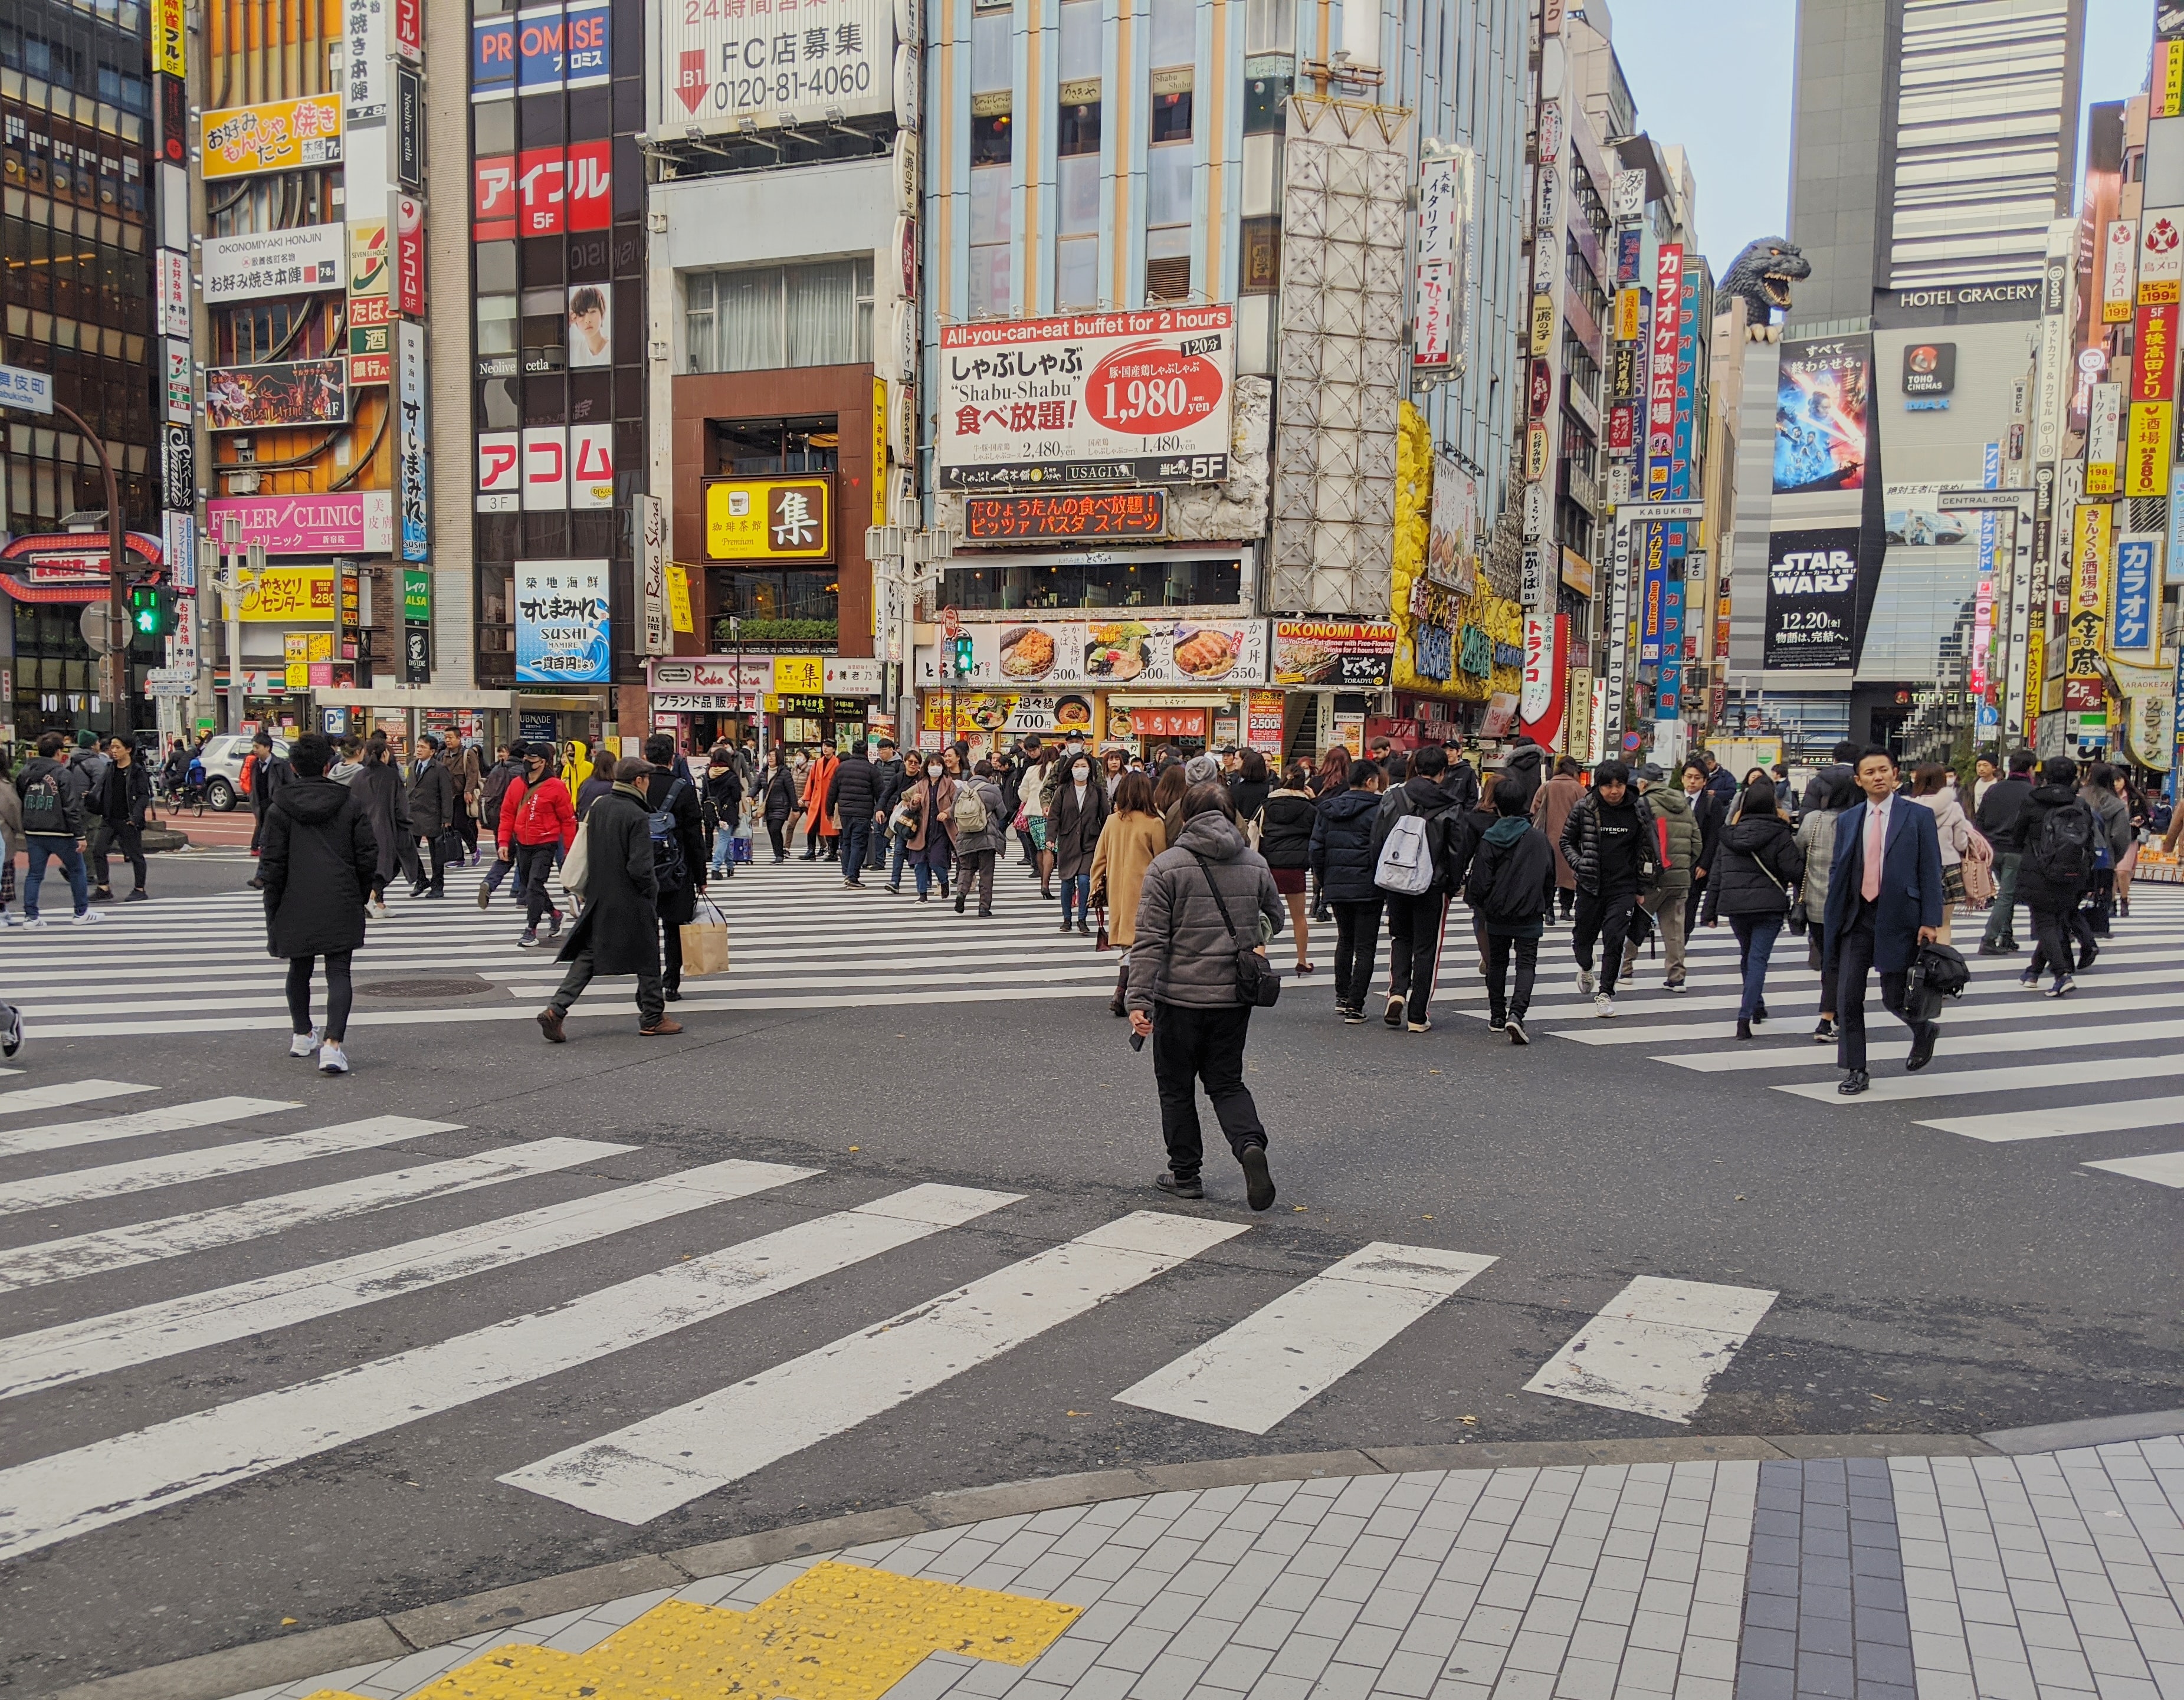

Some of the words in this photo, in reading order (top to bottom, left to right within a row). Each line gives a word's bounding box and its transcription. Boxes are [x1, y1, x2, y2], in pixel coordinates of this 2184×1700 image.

[402, 44, 414, 57] 5F
[481, 17, 604, 64] PROMISE
[722, 22, 863, 72] FC店募集
[166, 61, 179, 72] 6F
[683, 70, 703, 88] B1
[714, 62, 870, 110] 0120-81-4060
[1155, 75, 1178, 83] Shabu
[1168, 81, 1192, 90] Shabu
[292, 103, 336, 137] 焼き
[207, 112, 257, 150] お好み
[224, 118, 286, 162] もんじゃ
[257, 133, 292, 166] たこ
[326, 140, 340, 159] 7F
[479, 157, 611, 209] アイフル
[533, 212, 554, 229] 5F
[1426, 179, 1439, 253] イタリアン
[1539, 216, 1552, 225] 6F
[218, 238, 283, 255] OKONOMIYAKI
[286, 233, 322, 247] HONJIN
[251, 253, 296, 267] 歌舞伎町名物
[402, 241, 417, 294] アコム
[2143, 261, 2178, 272] 鳥メロ
[211, 265, 302, 293] お好み焼き本陣
[2112, 261, 2127, 297] 鳥メロ
[2142, 282, 2177, 291] 生ビール
[405, 297, 416, 308] 3F
[1901, 291, 1955, 307] HOTEL
[1958, 284, 2039, 303] GRACERY
[1424, 281, 1442, 352] ひょうたん
[2109, 307, 2129, 316] 199
[2150, 307, 2165, 317] 5F
[946, 320, 1070, 347] All-you-can-eat
[1074, 317, 1124, 335] buffet
[1129, 314, 1154, 330] for
[1159, 314, 1171, 329] 2
[1176, 311, 1228, 328] hours
[1536, 310, 1552, 340] 虎の子
[365, 329, 386, 350] 酒
[1183, 337, 1219, 357] 120分
[1651, 251, 1681, 424] カラオケ歌広場
[2048, 320, 2058, 369] ネットカフェ
[1424, 354, 1438, 362] 7F
[1806, 343, 1844, 358] すべて
[2143, 319, 2166, 398] 豊後高田どり
[407, 338, 416, 393] 築地海鮮
[478, 361, 516, 375] Neolive
[525, 359, 549, 371] cetla
[951, 346, 1084, 382] しゃぶしゃぶ
[1791, 357, 1862, 374] 終わらせる。
[1907, 382, 1942, 390] CINEMAS
[1908, 375, 1934, 383] TOHO
[173, 401, 187, 410] ATM
[324, 402, 339, 416] 4F
[1103, 377, 1187, 425] 1,980
[1188, 401, 1211, 415] yen
[1904, 399, 1950, 411] IMAX
[2044, 382, 2055, 415] カプセル
[955, 399, 1078, 437] 食べ放題!
[2091, 389, 2105, 460] キタノイチバ
[2139, 418, 2162, 445] 酒場
[973, 451, 1022, 461] しゃぶしゃぶコース
[1022, 441, 1061, 459] 2,480
[1060, 446, 1077, 458] yen
[1087, 445, 1140, 456] しゃぶしゃぶコース
[1140, 435, 1180, 453] 1,480
[1179, 440, 1196, 452] yen
[1088, 438, 1110, 447] 国産鶏
[1531, 431, 1542, 474] お好み焼き
[481, 439, 614, 488] アコム
[1191, 457, 1224, 478] 5F
[1987, 448, 1998, 483] 747
[181, 459, 193, 507] スパークル
[489, 496, 509, 510] 3F
[1942, 495, 1989, 505] CENTRAL
[1992, 495, 2020, 503] ROAD
[293, 504, 362, 528] CLINIC
[711, 520, 763, 533] 珈琲茶館
[770, 491, 818, 546] 集
[971, 517, 1031, 536] ピッツァ
[1039, 514, 1086, 533] パスタ
[1094, 513, 1159, 532] スイーツ
[322, 534, 346, 545] 新宿院
[403, 540, 427, 549] SUSHI
[722, 536, 755, 546] Premium
[2080, 508, 2102, 589] きんくら酒場
[178, 526, 186, 585] ファイトフィット
[1772, 550, 1854, 572] STAR
[525, 576, 599, 589] 築地海鮮
[1523, 557, 1539, 590] かっぱ
[1769, 568, 1857, 577] スカイウォーカーの夜明け
[2031, 560, 2049, 605] 甘太郎
[260, 577, 302, 595] やきとり
[405, 580, 427, 593] レイク
[1611, 540, 1629, 649] GODZILLA
[1772, 574, 1854, 595] WARS
[2120, 544, 2148, 643] カラオケ
[261, 595, 306, 612] センター
[405, 595, 427, 607] ALSA
[179, 601, 190, 645] お好み焼
[2009, 545, 2029, 700] ゴジラロード
[2030, 611, 2044, 620] 4F
[539, 627, 587, 641] SUSHI
[647, 623, 661, 631] FREE
[1060, 626, 1069, 646] そば
[1278, 622, 1357, 639] OKONOMI
[1358, 623, 1397, 639] YAKI
[1543, 615, 1553, 653] 大衆酒場
[1069, 625, 1081, 666] かき揚げ
[1149, 624, 1159, 667] ラーメン
[1161, 624, 1172, 668] とんこつ
[1229, 630, 1245, 654] 大人気
[1247, 621, 1261, 665] かつ丼
[1525, 620, 1543, 682] トラノコ
[1660, 592, 1680, 707] カラオケ館
[2068, 609, 2105, 676] 金の蔵
[176, 648, 194, 659] 本陣
[799, 662, 820, 689] 集
[1052, 667, 1081, 681] 500円
[1139, 667, 1170, 681] 500円
[1231, 667, 1262, 680] 550円
[1608, 659, 1623, 712] ROAD
[658, 695, 712, 709] ブランド品
[327, 713, 336, 731] P
[1014, 714, 1051, 729] 700円
[1134, 716, 1202, 733] とらそば
[1250, 718, 1281, 730] 2,500円
[2144, 696, 2165, 760] カラオケ
